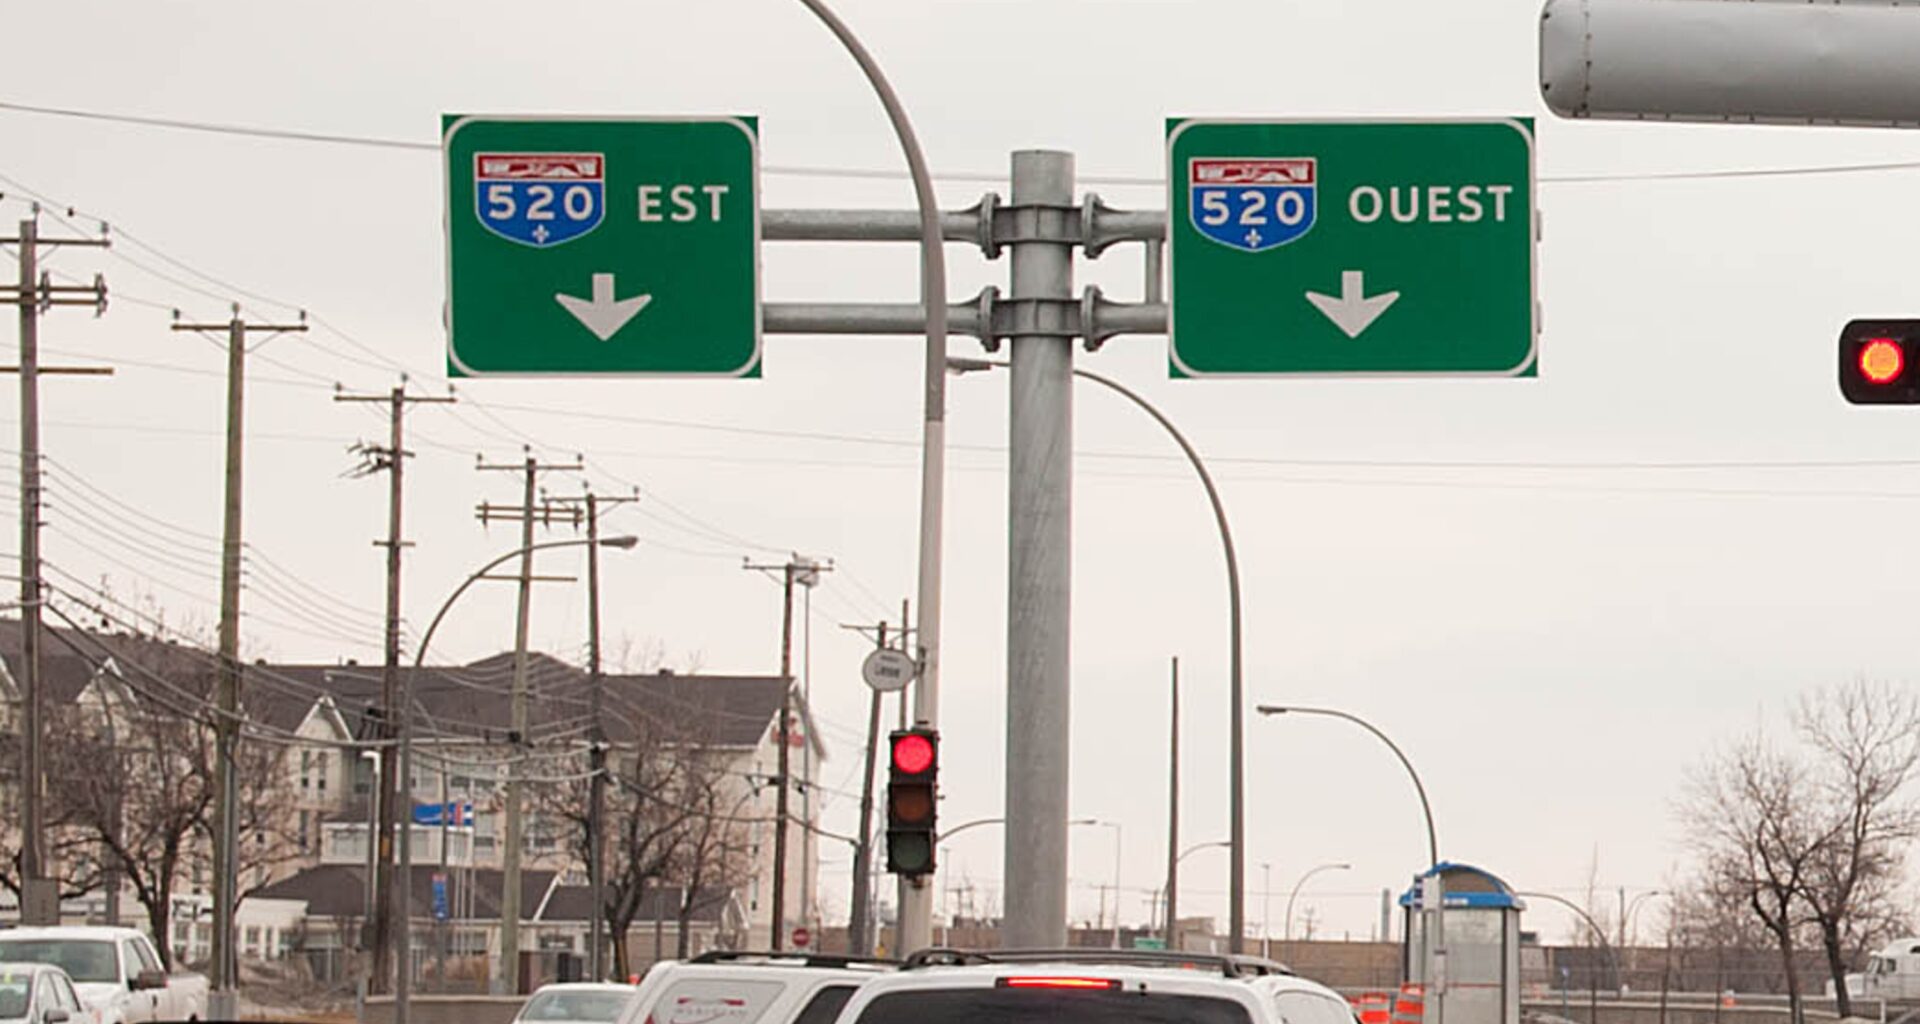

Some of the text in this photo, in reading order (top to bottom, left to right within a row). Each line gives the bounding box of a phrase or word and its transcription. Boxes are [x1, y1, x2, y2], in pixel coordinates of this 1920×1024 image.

[488, 185, 729, 222] 520 EST
[1202, 186, 1513, 226] 520 OUEST
